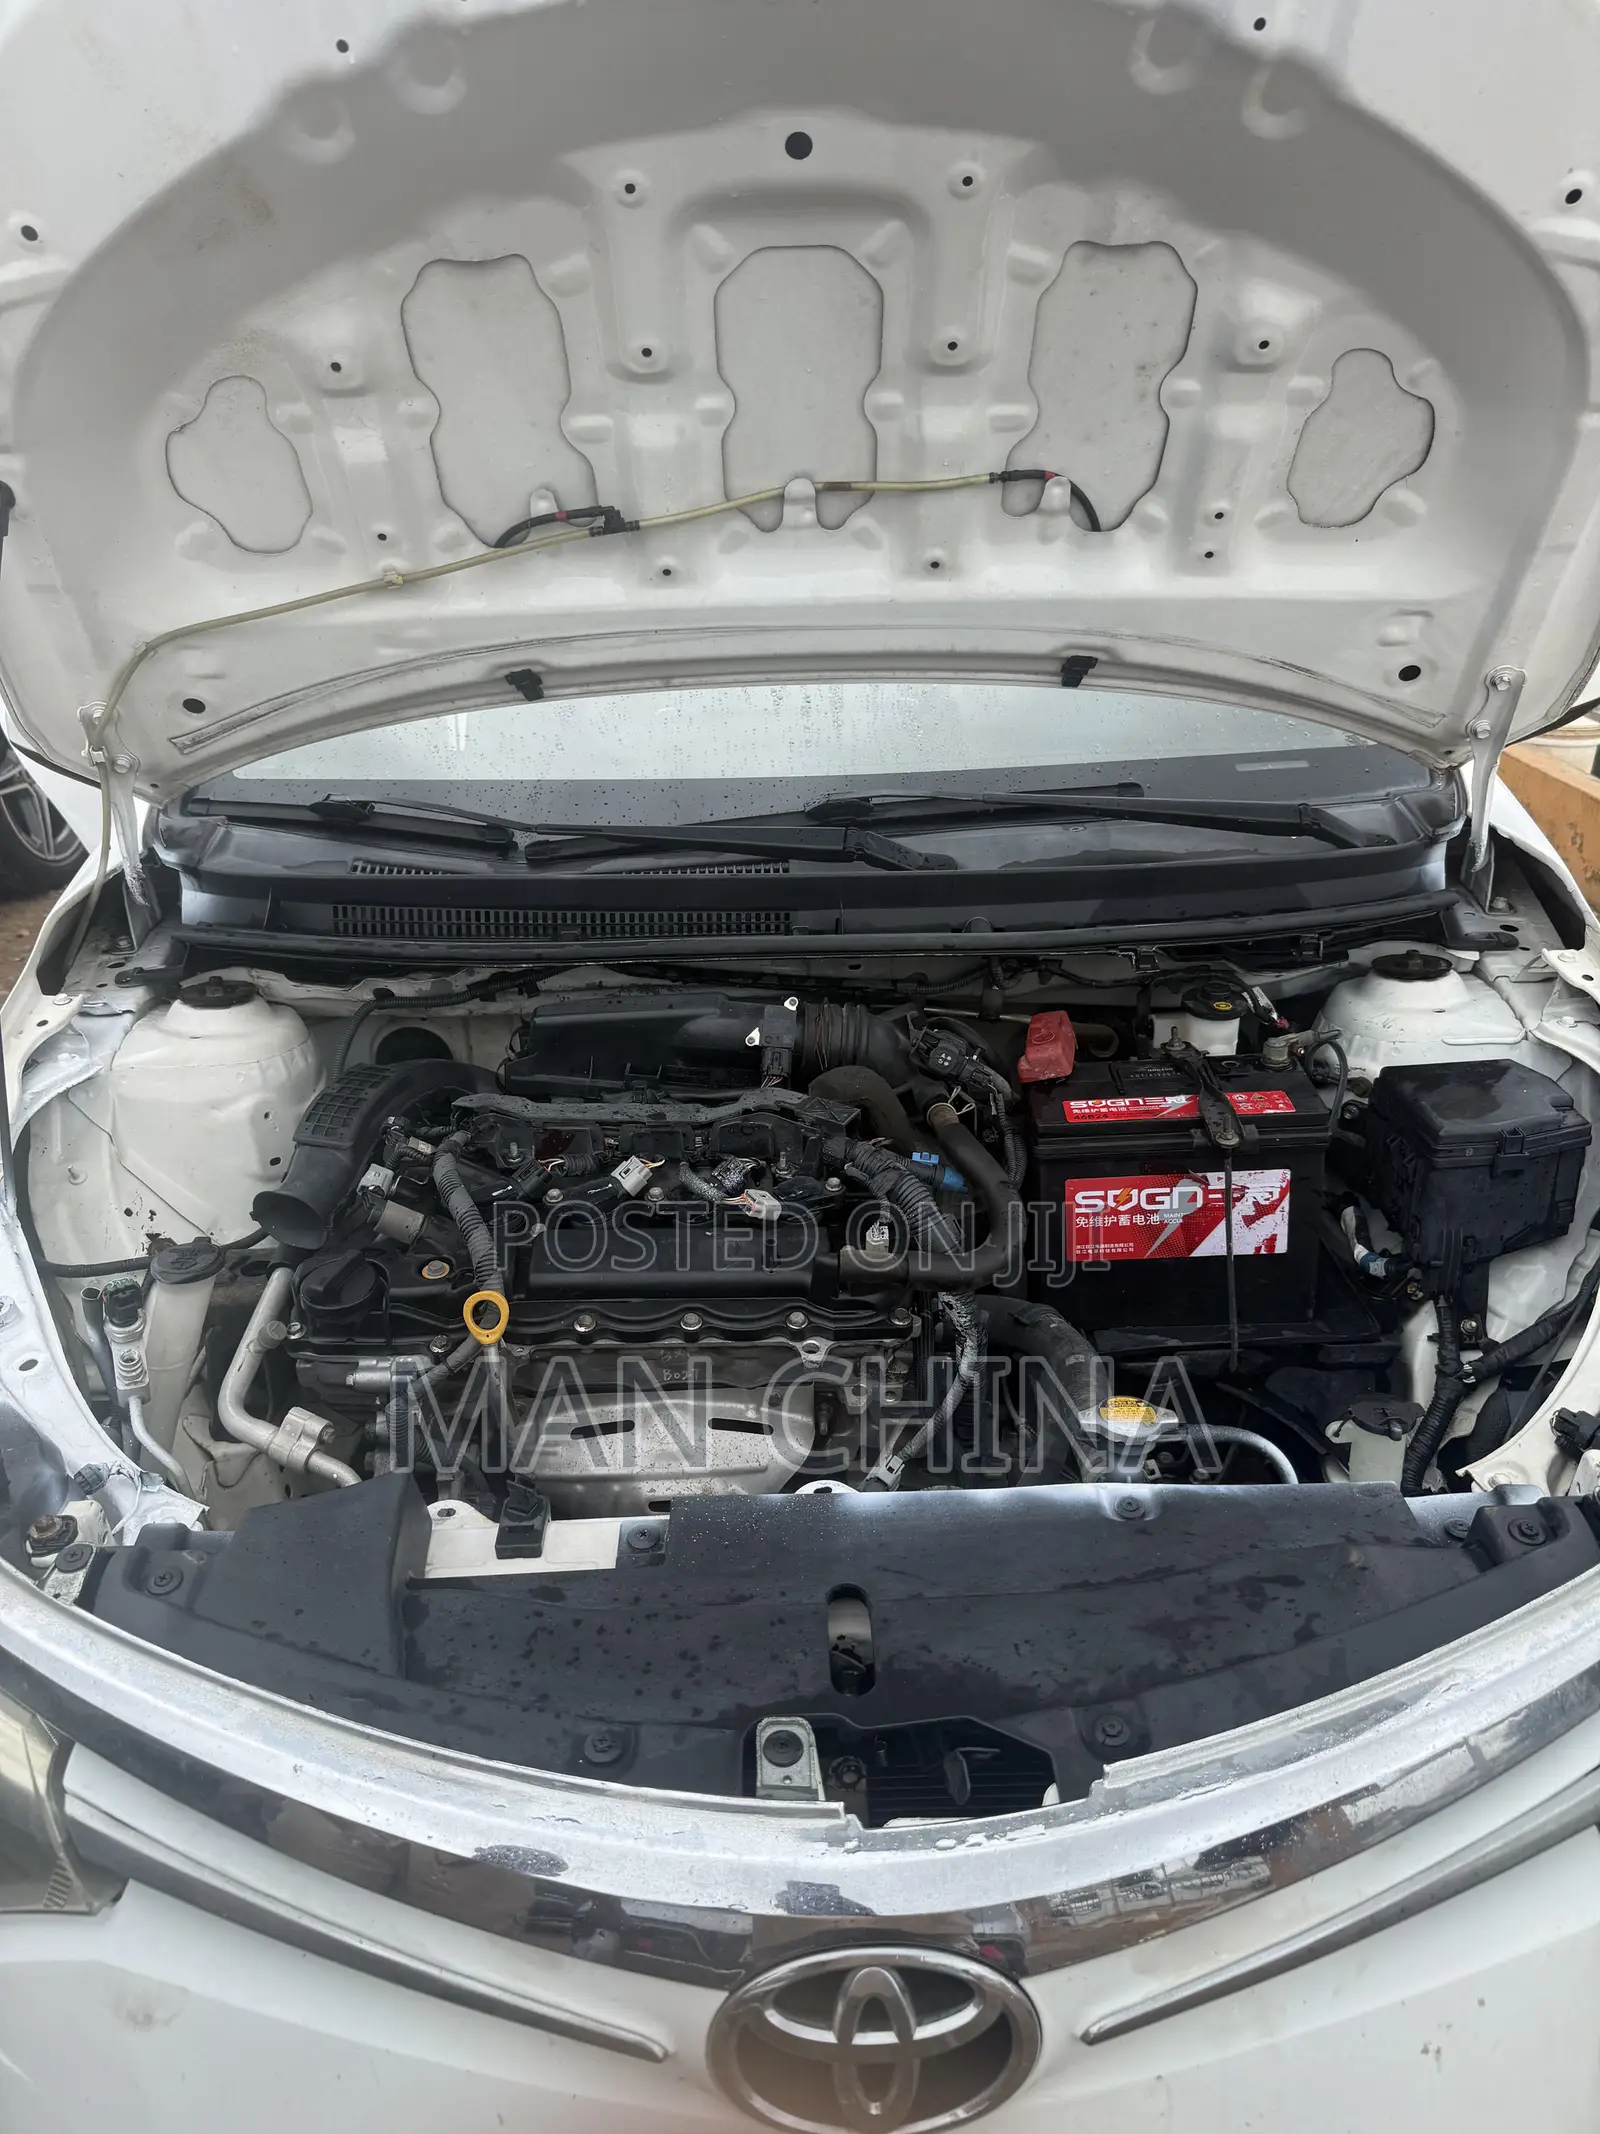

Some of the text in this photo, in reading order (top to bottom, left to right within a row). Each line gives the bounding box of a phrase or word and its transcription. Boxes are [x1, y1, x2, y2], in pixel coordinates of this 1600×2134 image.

[1075, 1212, 1160, 1228] 免维护蓄电池
